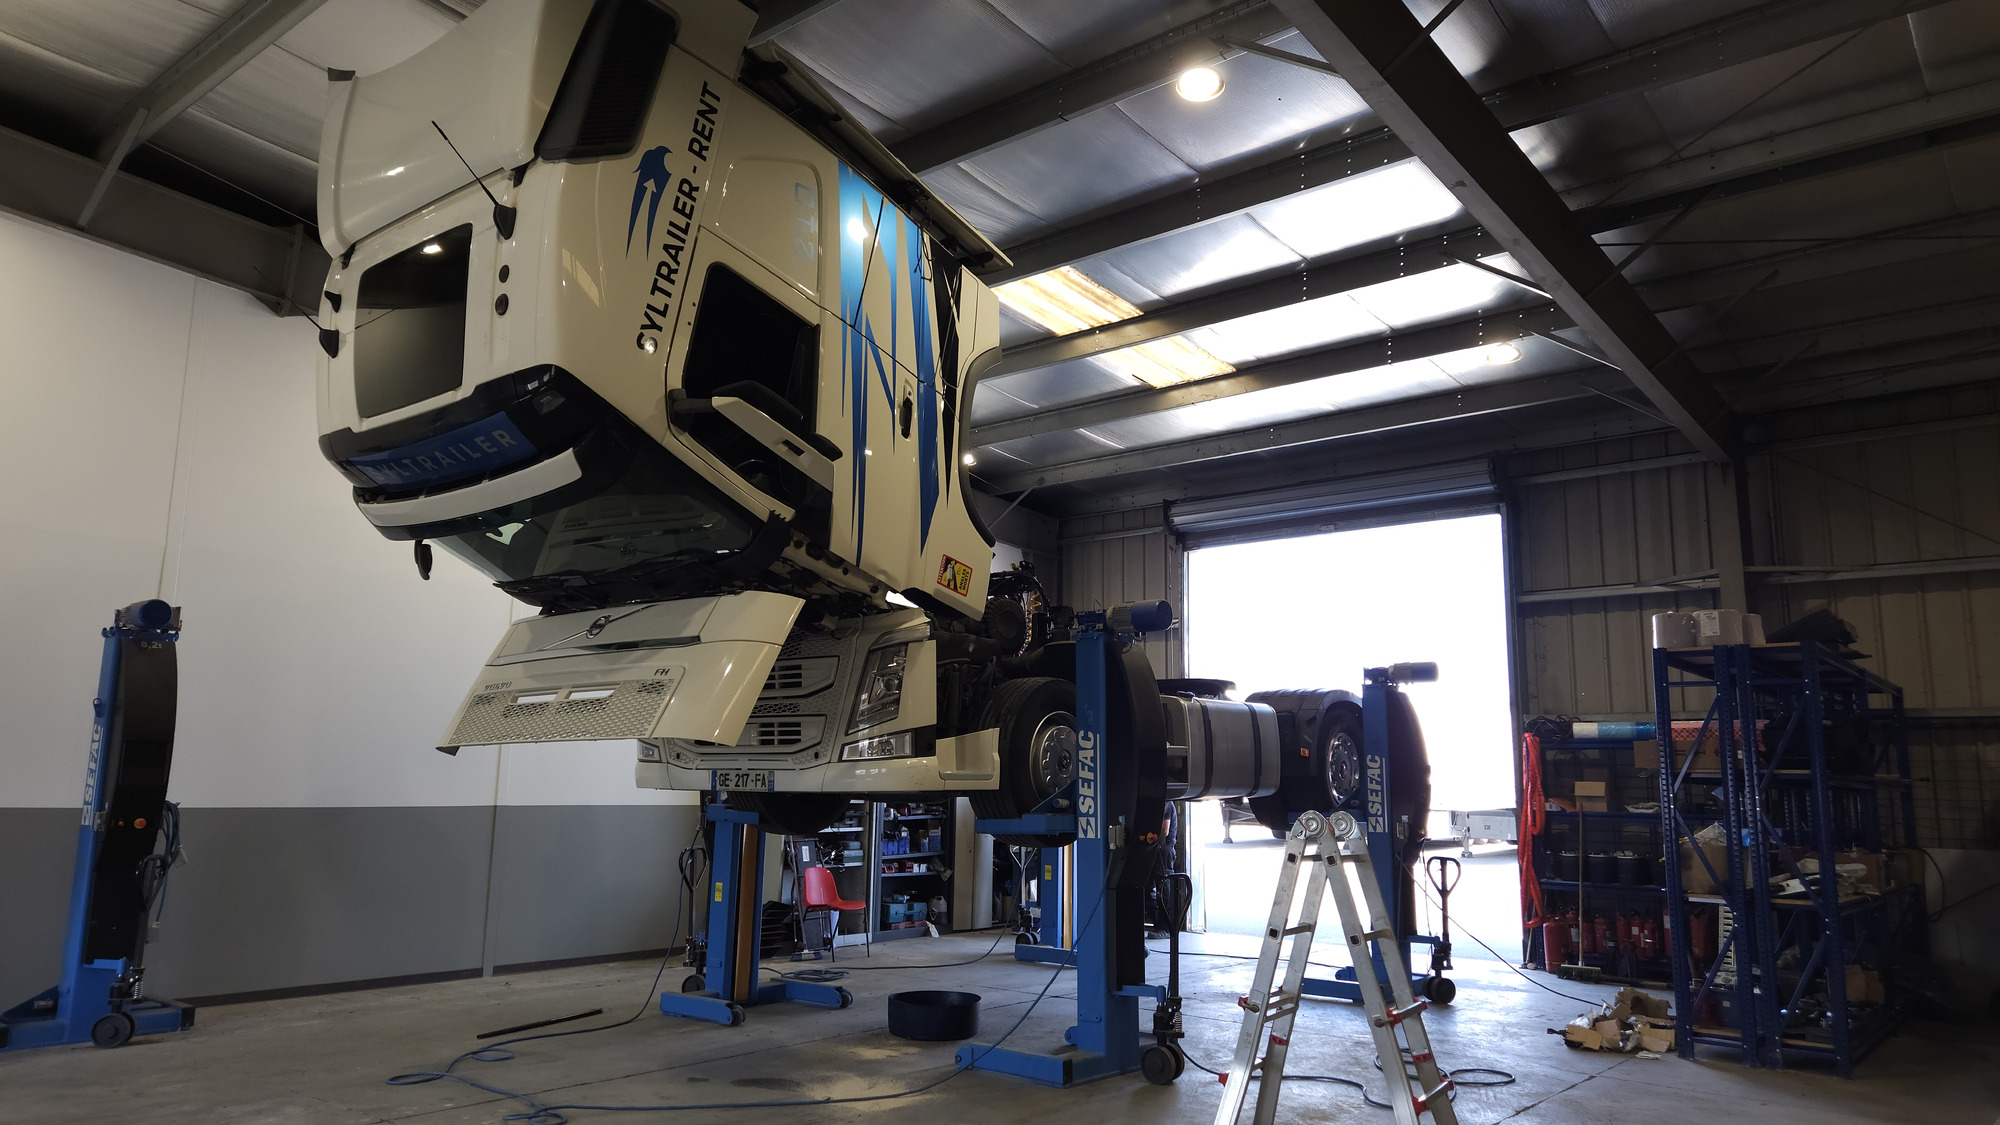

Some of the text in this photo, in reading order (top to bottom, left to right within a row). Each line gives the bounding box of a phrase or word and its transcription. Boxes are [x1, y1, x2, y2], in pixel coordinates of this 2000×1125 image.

[636, 177, 700, 353] SYLTRAILER
[688, 81, 721, 162] RENT
[654, 668, 671, 677] FH
[83, 723, 103, 805] SEFAC
[1078, 729, 1095, 815] SEFAC
[1366, 754, 1383, 816] SEFAC
